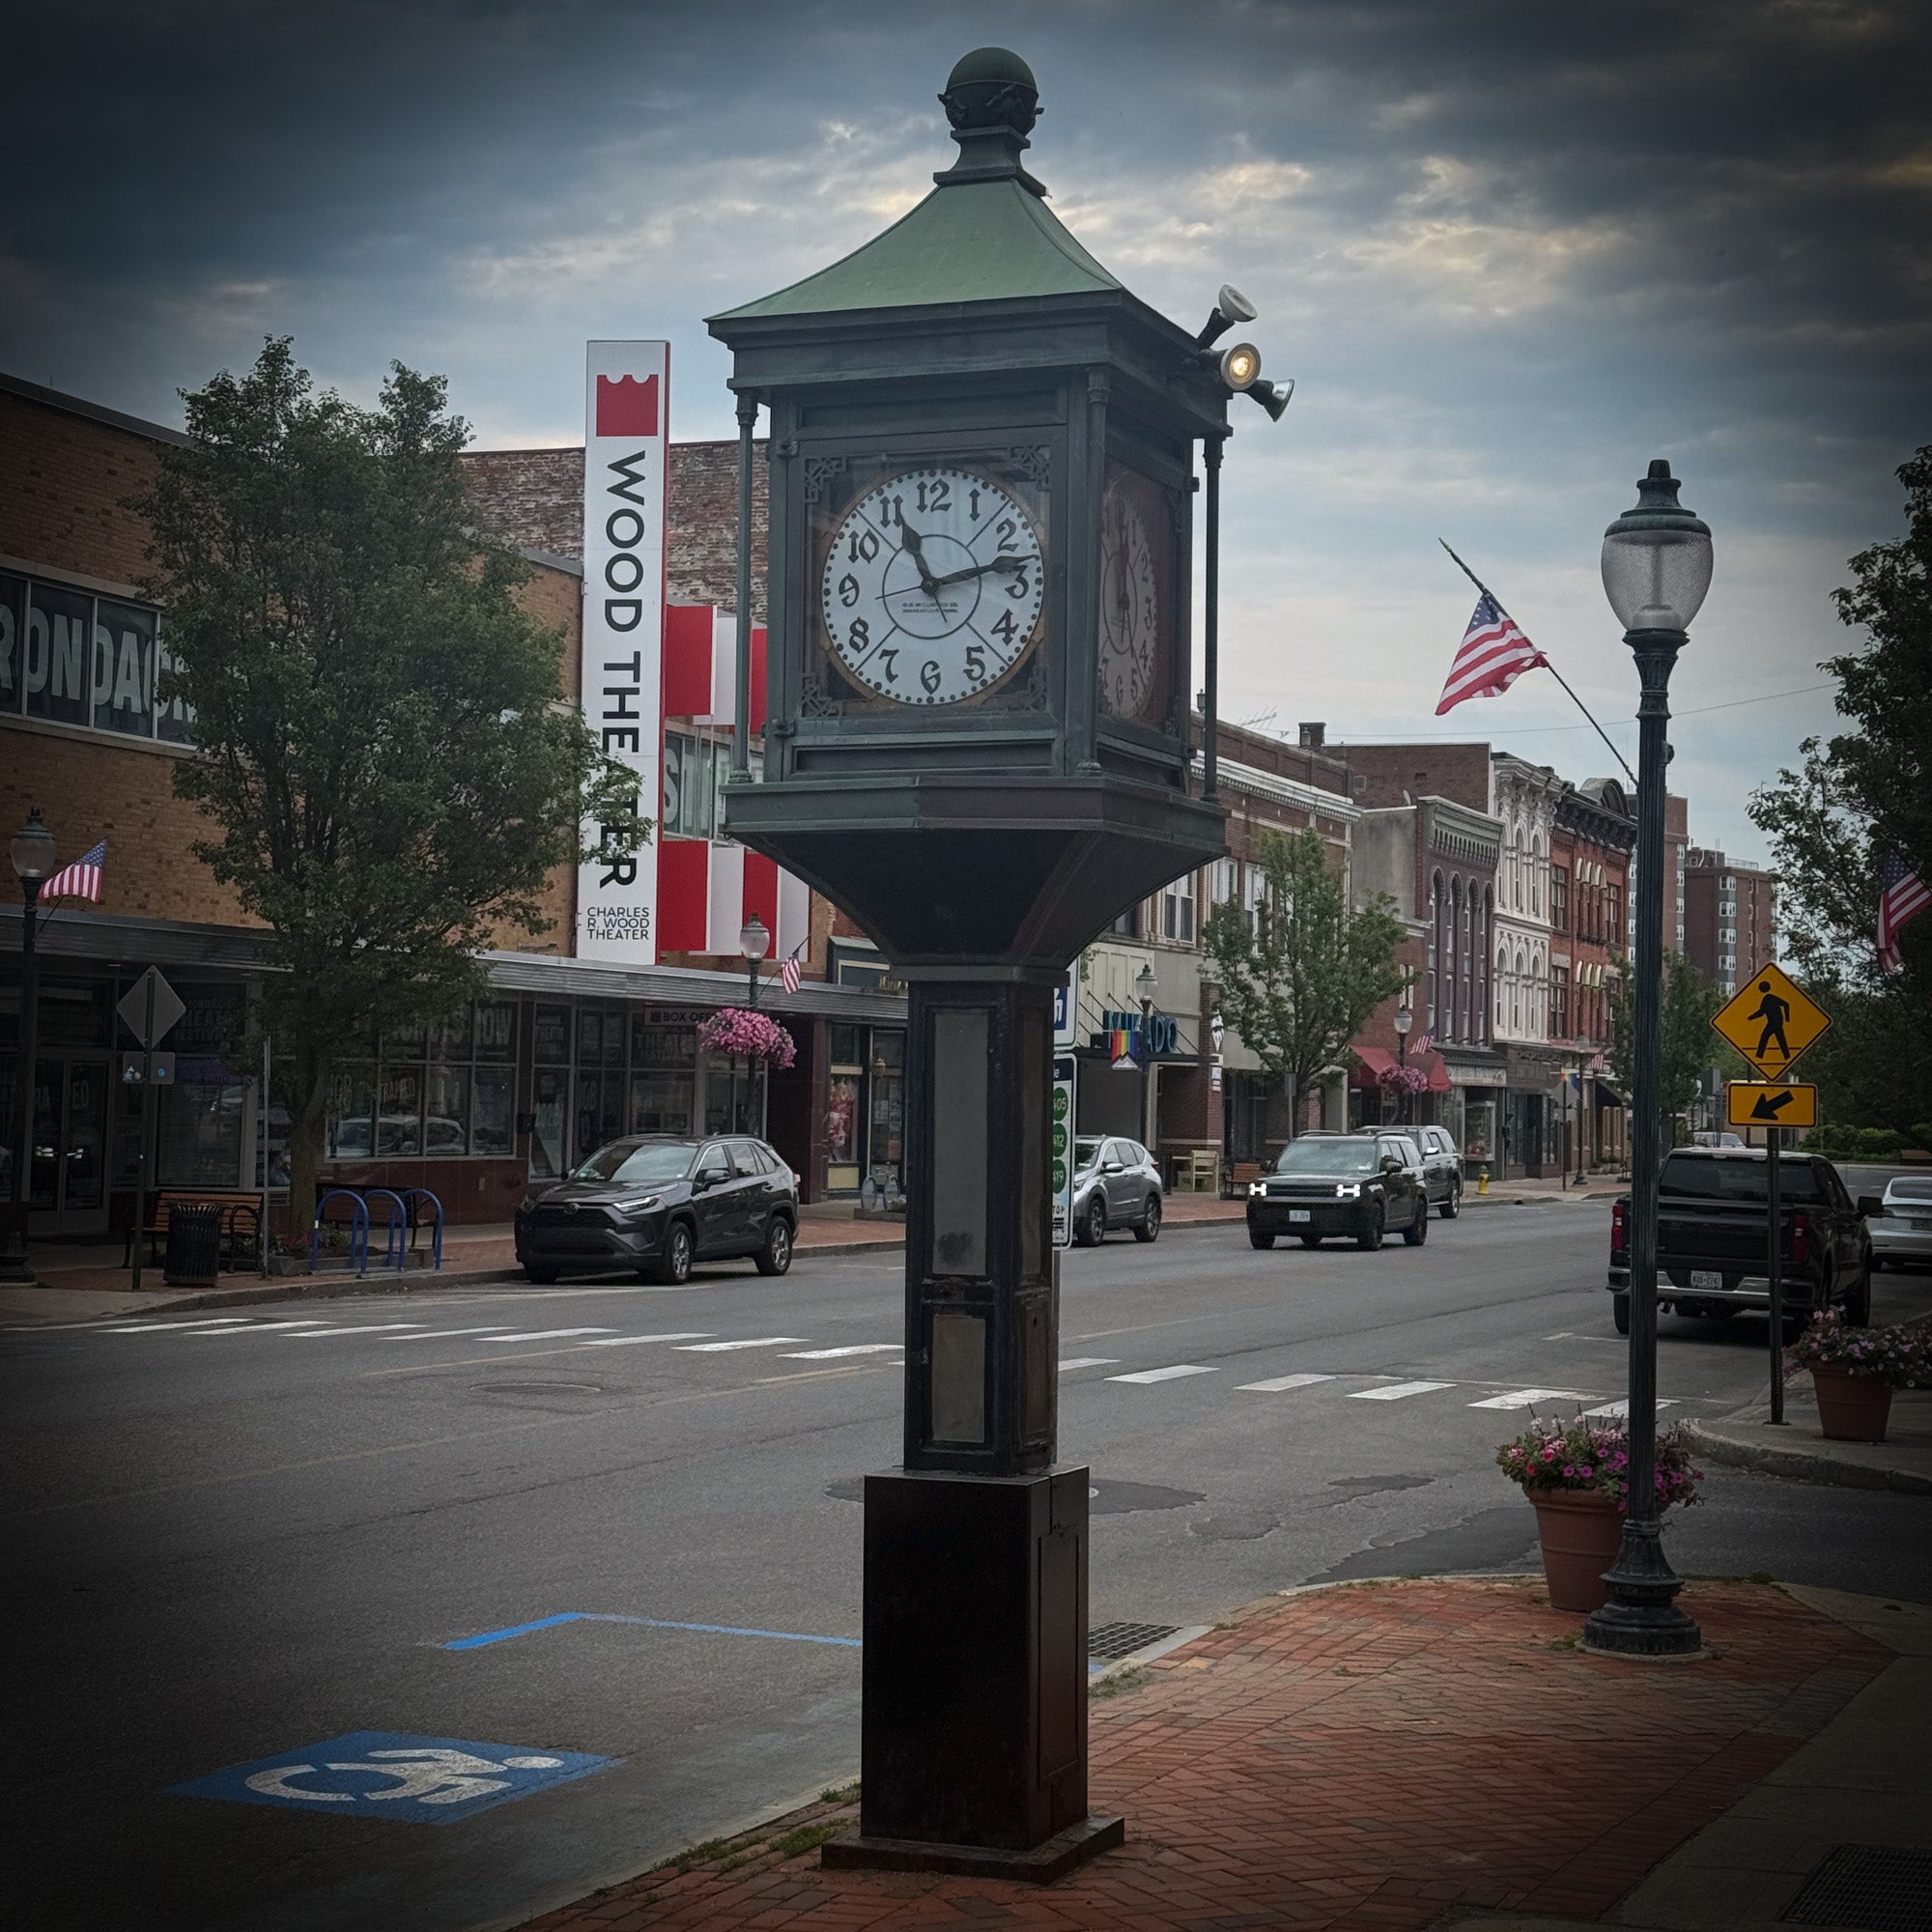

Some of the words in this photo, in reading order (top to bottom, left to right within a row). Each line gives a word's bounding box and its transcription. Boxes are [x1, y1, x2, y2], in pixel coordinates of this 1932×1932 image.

[880, 494, 904, 528] 11
[917, 478, 952, 513] 12
[969, 488, 980, 522] 1
[604, 450, 645, 632] WOOD
[848, 528, 879, 563] 10
[996, 518, 1019, 552] 2
[838, 572, 860, 607] 9
[1005, 563, 1029, 599] 3
[849, 616, 869, 654] 8
[990, 609, 1020, 645] 4
[878, 648, 899, 683] 7
[963, 645, 986, 681] 5
[1139, 639, 1150, 671] 4
[920, 660, 941, 695] 6
[1116, 674, 1123, 706] 6
[586, 906, 649, 918] CHARLES
[603, 918, 649, 928] WOOD
[586, 928, 649, 940] THEATER
[663, 1011, 686, 1022] BOX
